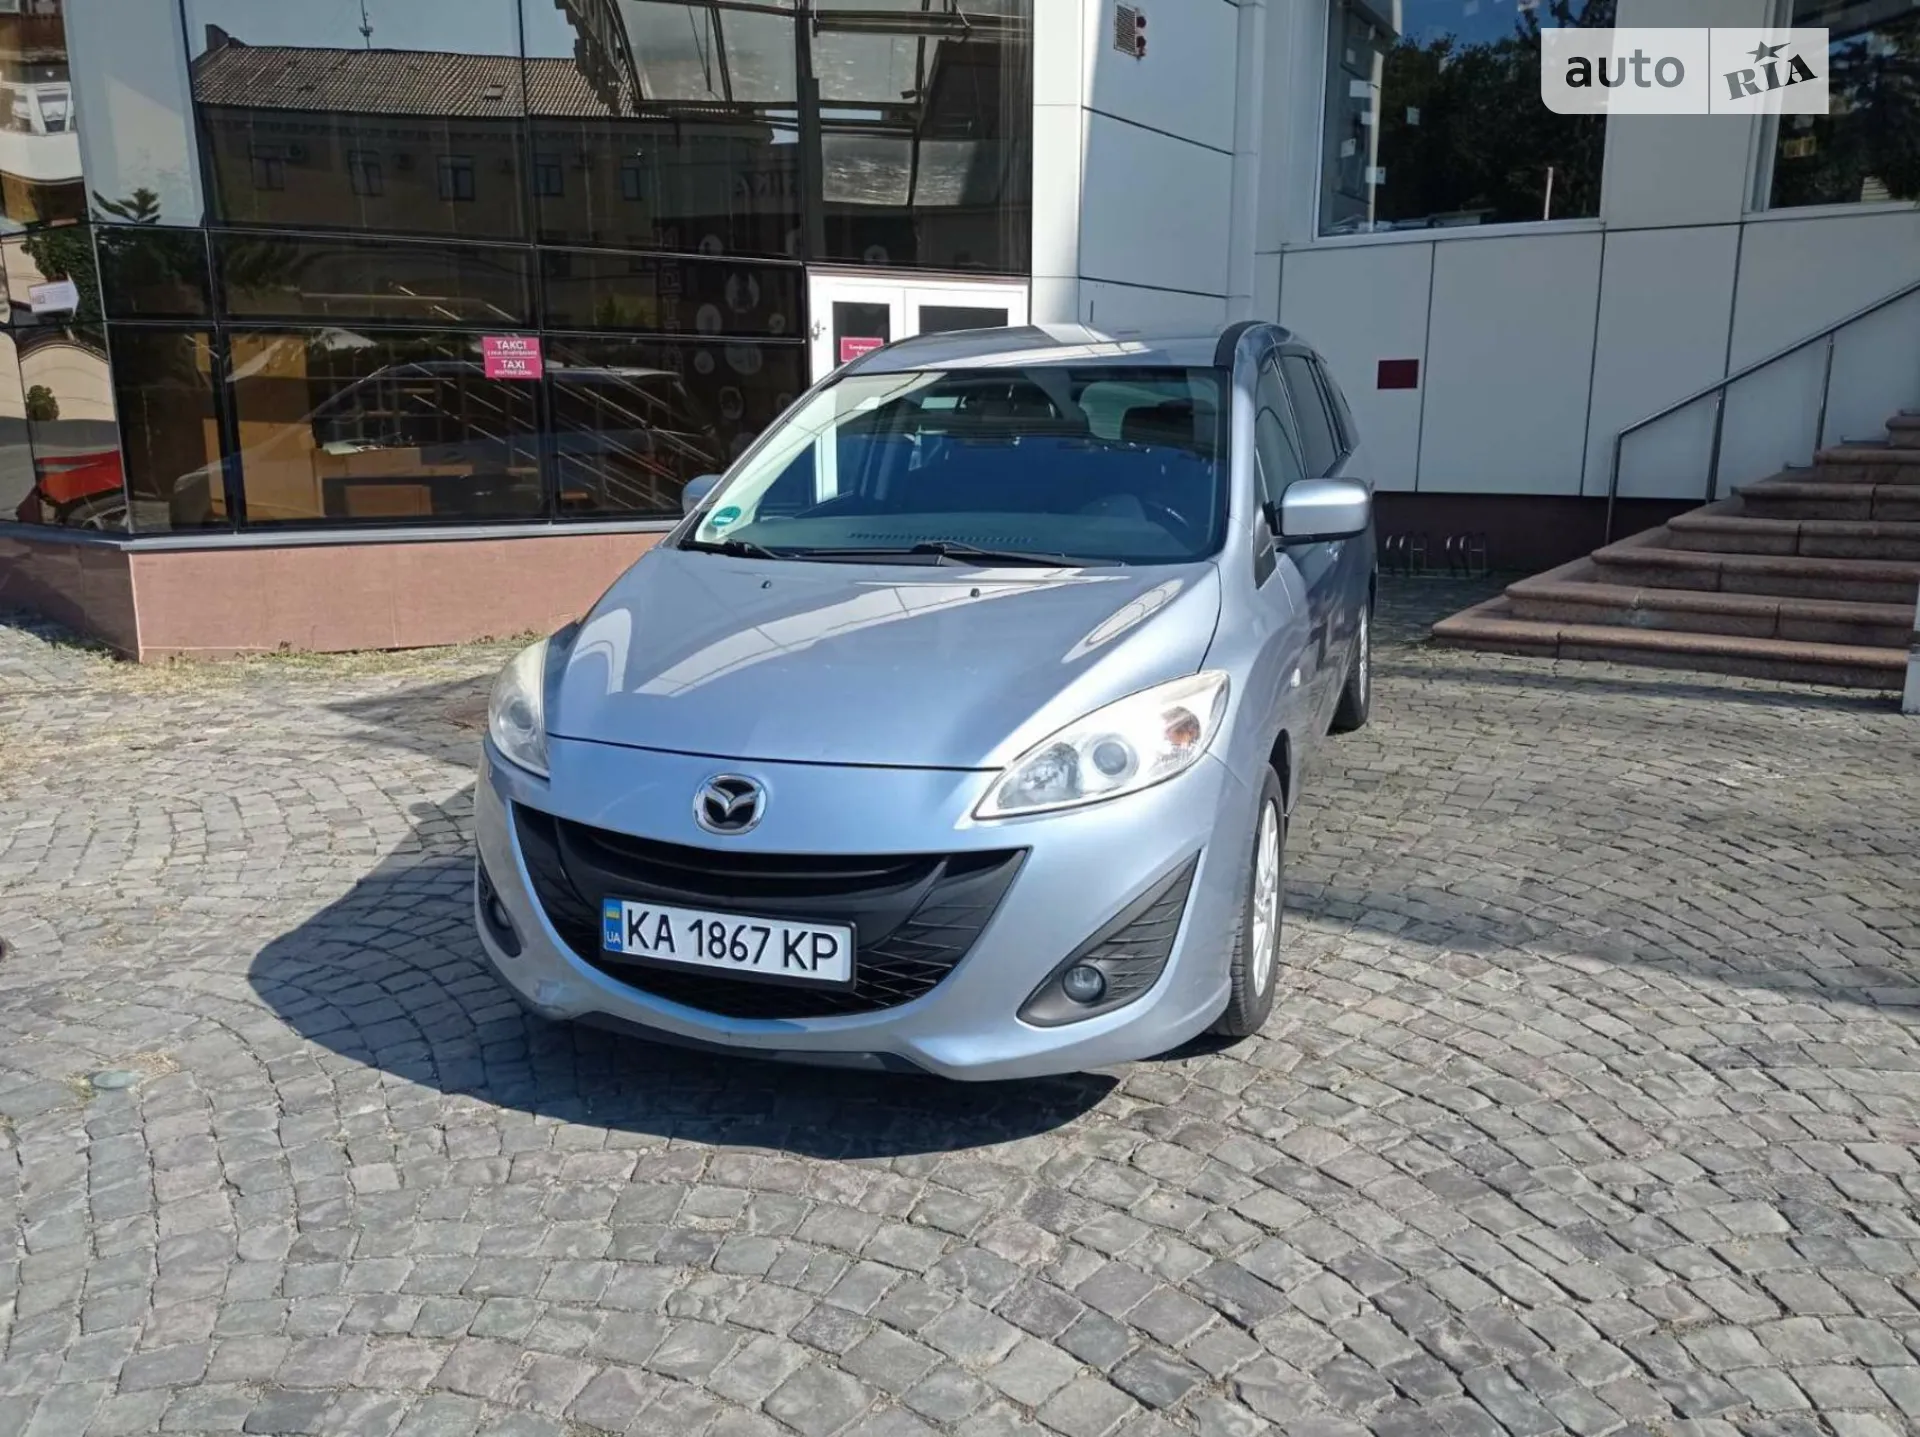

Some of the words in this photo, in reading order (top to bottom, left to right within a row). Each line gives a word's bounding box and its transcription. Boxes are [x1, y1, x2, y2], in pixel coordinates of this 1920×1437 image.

[500, 359, 525, 369] TAXI
[606, 931, 621, 945] UA
[627, 909, 676, 953] KA
[688, 919, 771, 965] 1867
[783, 929, 838, 971] KP
